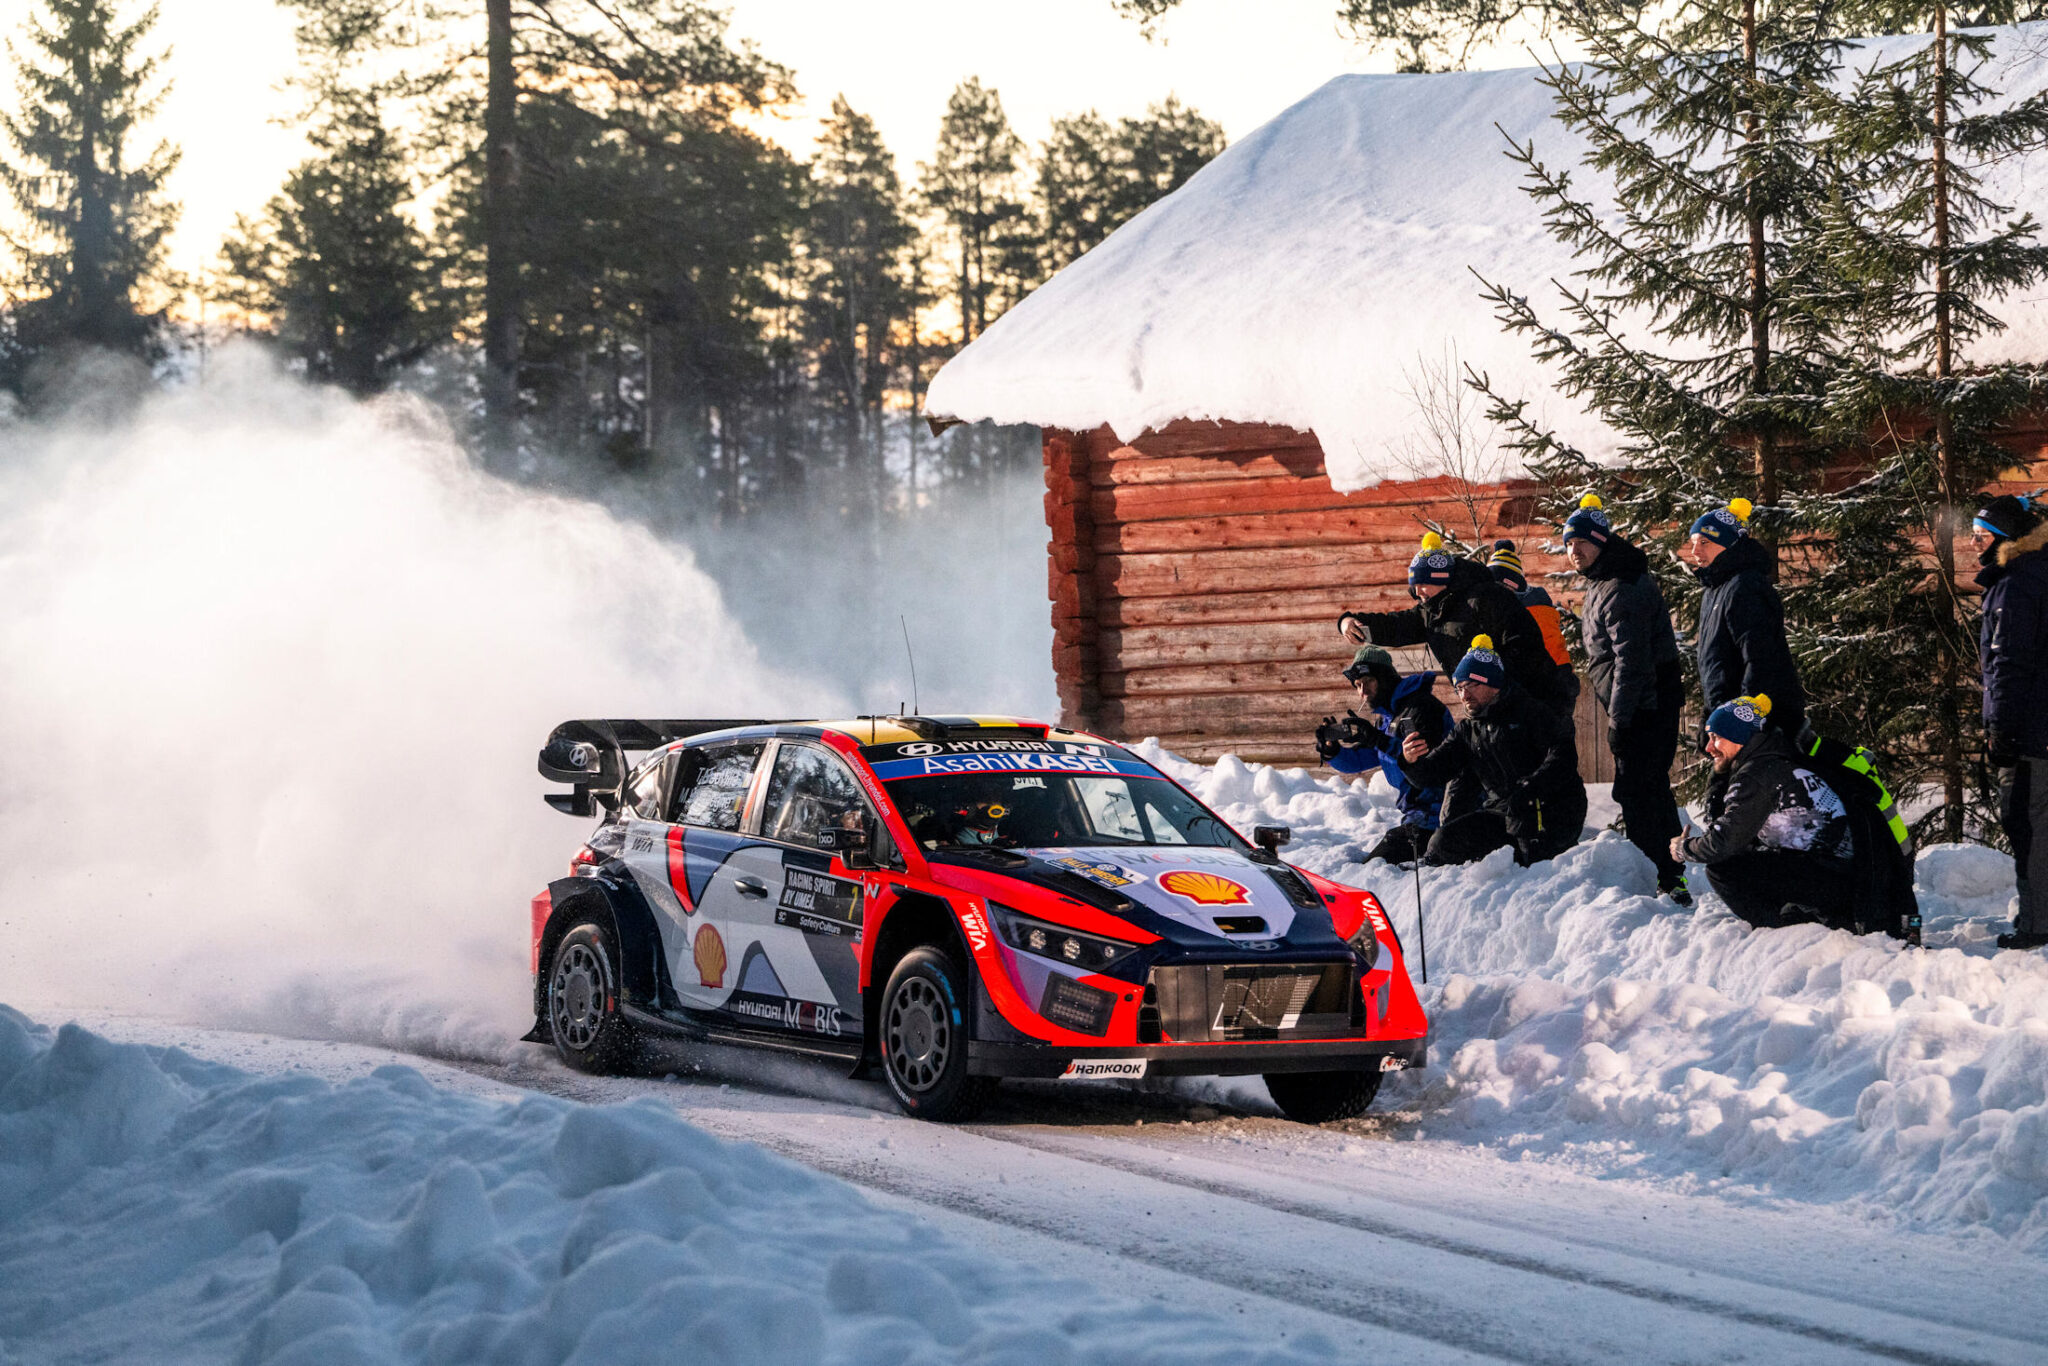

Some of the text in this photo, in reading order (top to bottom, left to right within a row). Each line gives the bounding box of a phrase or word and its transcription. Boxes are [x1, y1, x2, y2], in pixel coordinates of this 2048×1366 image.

[947, 741, 1055, 751] HYUNDAI
[924, 754, 1119, 774] AsahiKASEI
[1056, 857, 1092, 870] RALLY
[1086, 867, 1133, 886] SWEDEN
[788, 871, 836, 897] RACING SPIRIT
[783, 888, 796, 904] BY
[800, 916, 841, 935] SafetyCulture
[738, 999, 841, 1037] HYUNDAI MOBIS
